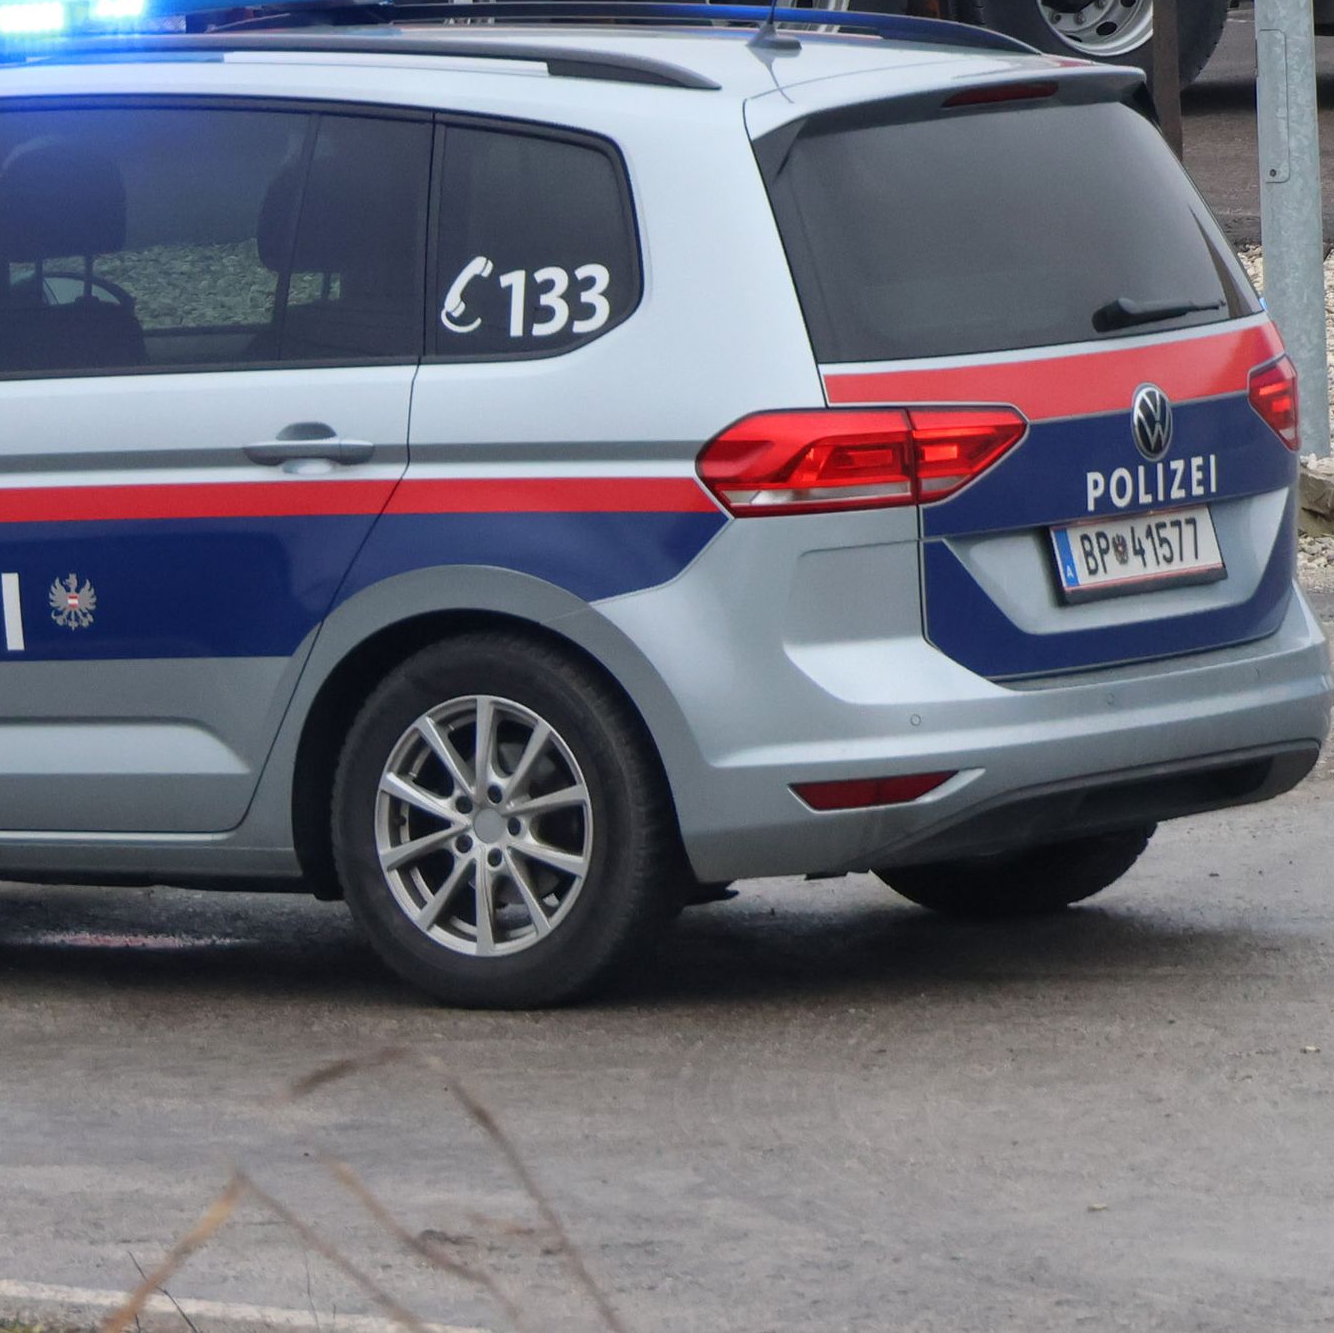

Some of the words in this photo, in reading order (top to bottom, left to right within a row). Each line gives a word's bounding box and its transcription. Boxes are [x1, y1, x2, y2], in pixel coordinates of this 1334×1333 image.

[499, 264, 611, 337] 133
[1086, 454, 1216, 511] POLIZEI
[1080, 531, 1110, 576] BP
[1130, 517, 1199, 568] 41577
